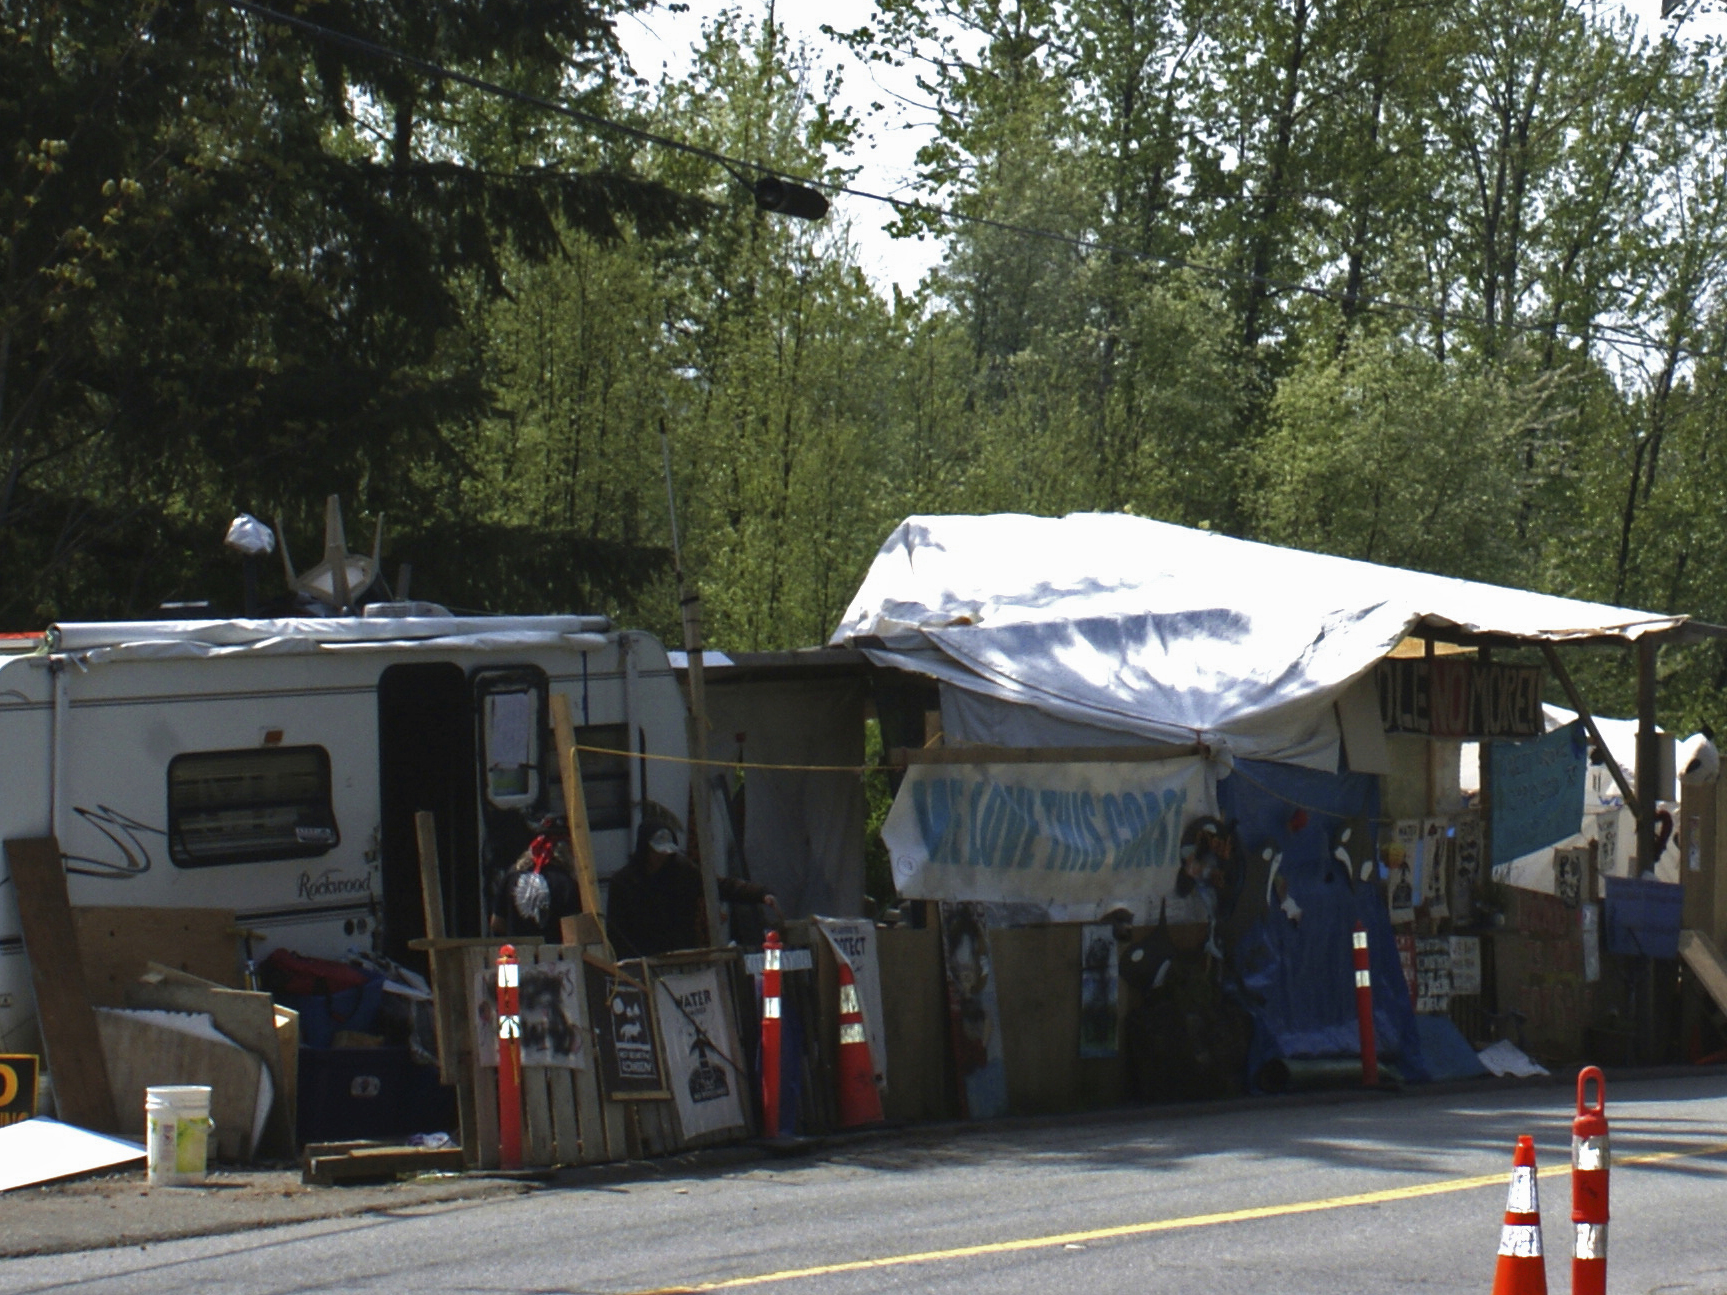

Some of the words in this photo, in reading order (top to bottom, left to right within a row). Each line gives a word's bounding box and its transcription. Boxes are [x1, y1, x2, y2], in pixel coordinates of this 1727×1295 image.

[1430, 662, 1467, 734] NO
[912, 778, 963, 865] WE
[968, 781, 1040, 869] LOVE
[1040, 789, 1106, 872] THIS
[1103, 789, 1187, 870] COAST
[299, 869, 371, 901] Rockwood
